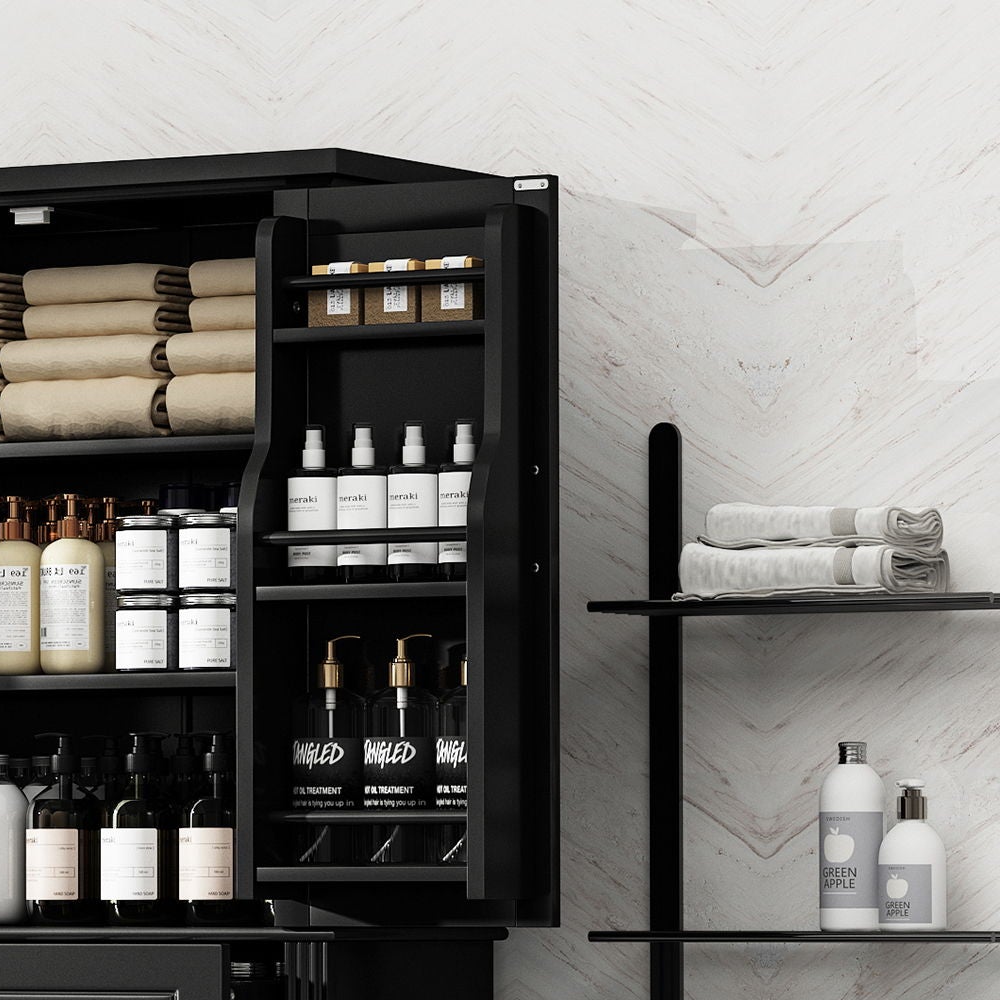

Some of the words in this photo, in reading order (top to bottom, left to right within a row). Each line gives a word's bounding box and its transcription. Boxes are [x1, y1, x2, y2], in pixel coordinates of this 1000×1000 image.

[306, 786, 342, 795] TREATMENT
[378, 785, 414, 794] TREATMENT
[822, 867, 857, 878] GREEN
[823, 878, 855, 889] APPLE
[885, 901, 910, 909] GREEN
[886, 909, 909, 917] APPLE
